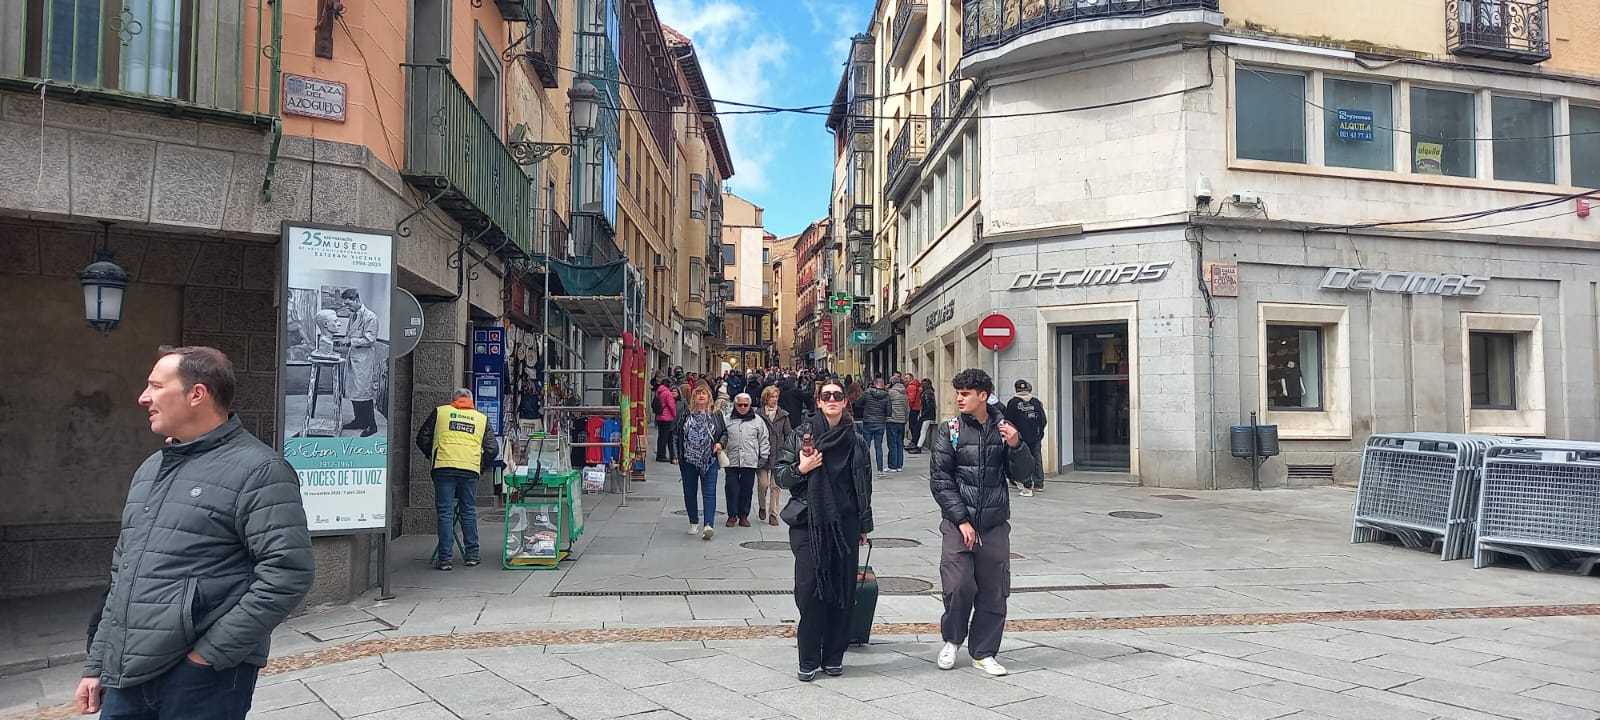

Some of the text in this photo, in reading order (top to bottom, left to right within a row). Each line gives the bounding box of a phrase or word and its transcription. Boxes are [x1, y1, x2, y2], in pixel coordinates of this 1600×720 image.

[304, 82, 342, 95] PLAZA
[287, 97, 342, 114] AZOGUEJO
[1339, 122, 1371, 131] ALQUILA
[302, 231, 322, 246] 25
[322, 241, 367, 251] MUSEO
[1008, 259, 1175, 292] DECIMAS
[1318, 267, 1490, 297] DECIMAS
[456, 425, 474, 433] ONCE
[283, 437, 388, 457] Esteban Vicente
[307, 470, 336, 486] VOCES
[338, 470, 349, 486] DE
[351, 469, 362, 486] TU
[365, 469, 382, 485] VOZ
